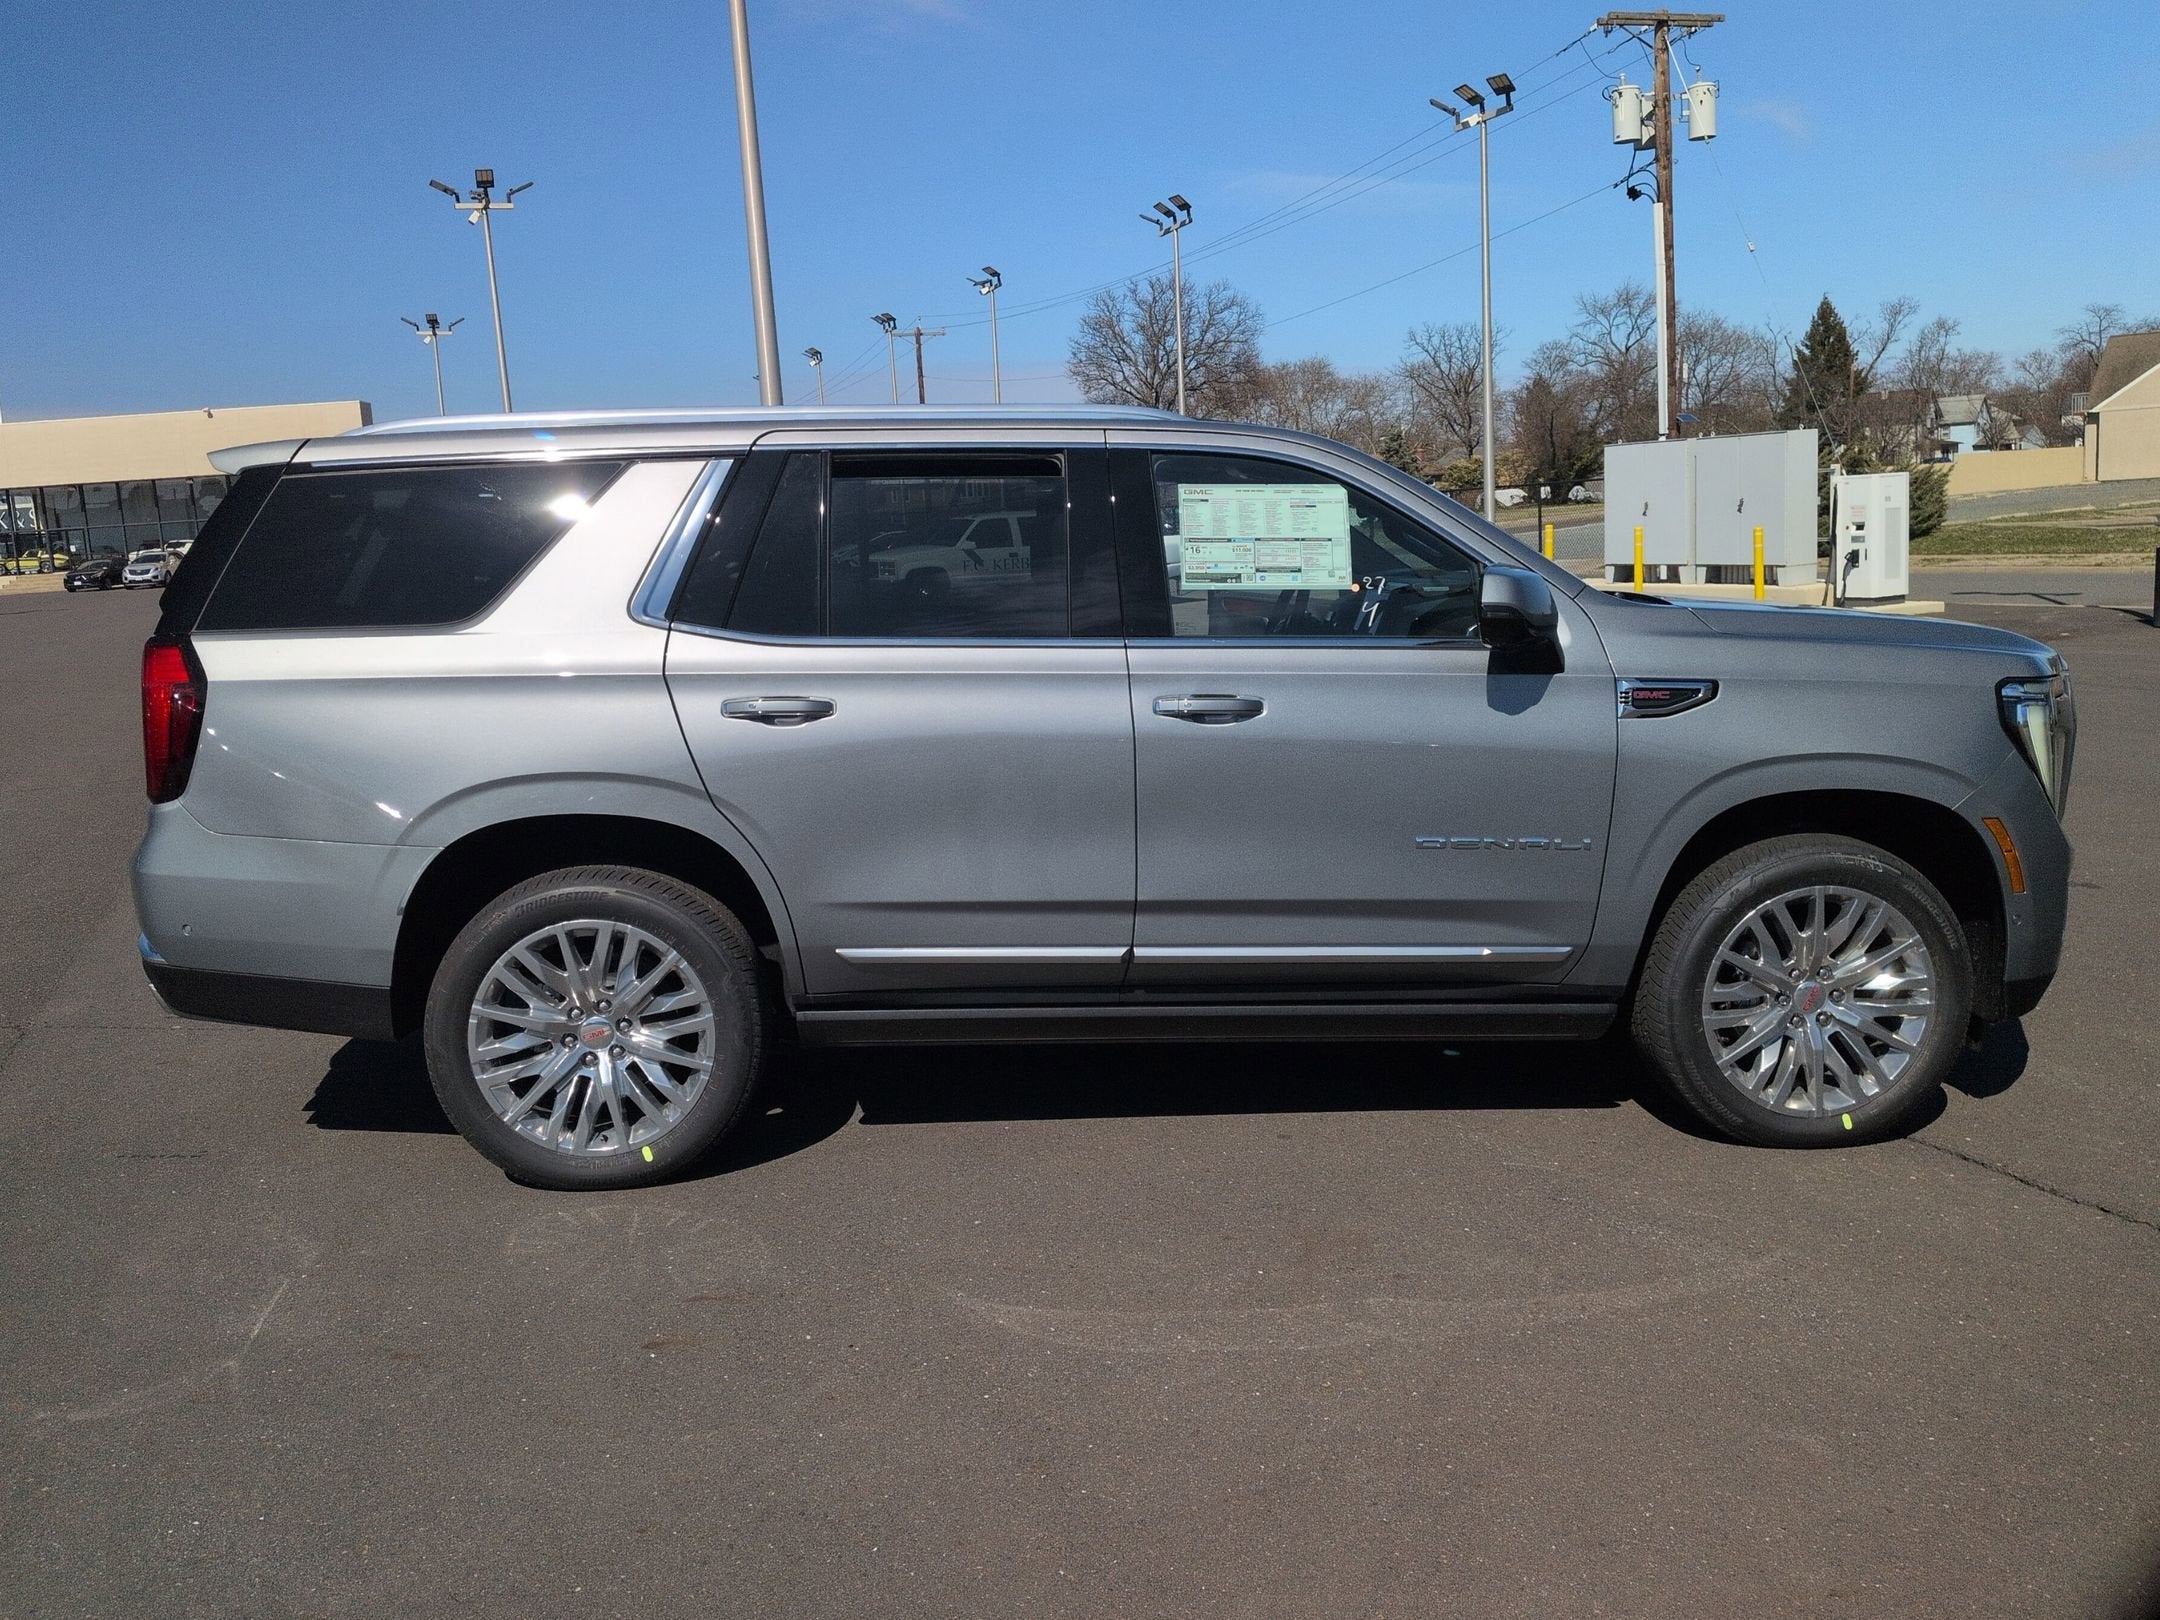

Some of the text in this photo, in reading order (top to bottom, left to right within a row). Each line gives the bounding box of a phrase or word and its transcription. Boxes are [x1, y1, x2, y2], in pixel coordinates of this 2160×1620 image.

[1190, 546, 1201, 554] 16
[1362, 576, 1386, 595] 27
[1633, 690, 1671, 700] GMC
[1415, 836, 1592, 851] DENALI
[514, 890, 610, 918] BRIDGESTONE
[1802, 984, 1821, 1012] GMC
[582, 1026, 611, 1042] GMC
